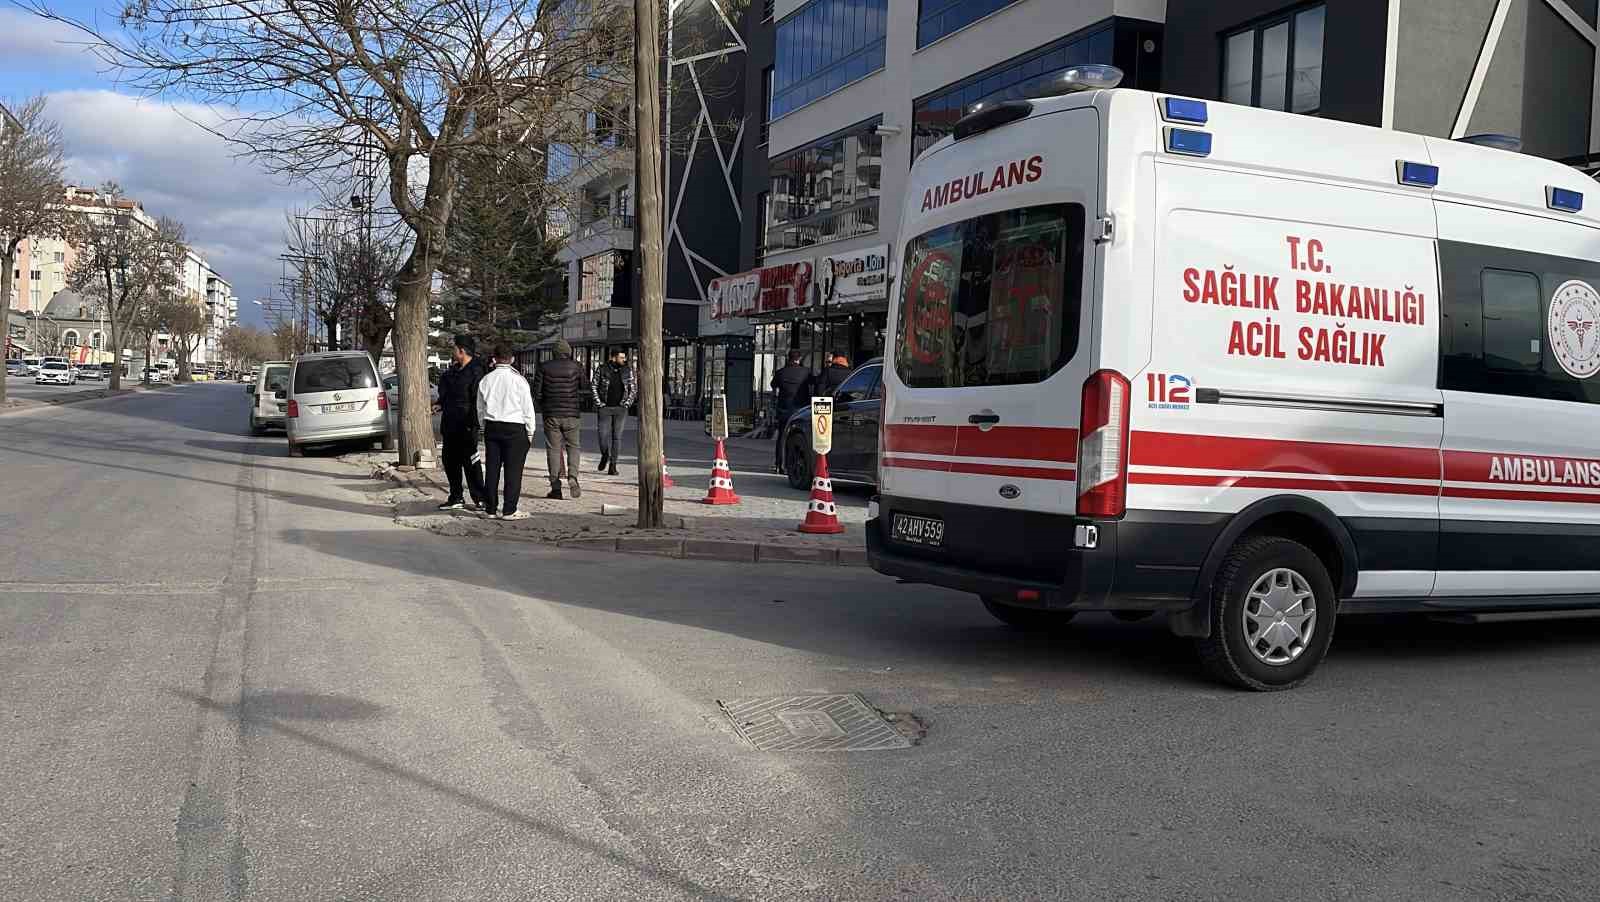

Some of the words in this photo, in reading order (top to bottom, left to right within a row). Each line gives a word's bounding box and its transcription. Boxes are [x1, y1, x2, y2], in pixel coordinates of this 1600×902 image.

[921, 155, 1043, 213] AMBULANS
[1286, 235, 1332, 273] T.C.
[1183, 263, 1280, 311] SAĞLIK
[1296, 283, 1425, 326] BAKANLIĞI
[1227, 316, 1286, 359] ACİL
[1297, 322, 1387, 367] SAĞLIK
[1146, 372, 1191, 403] 112
[1488, 456, 1600, 486] AMBULANS
